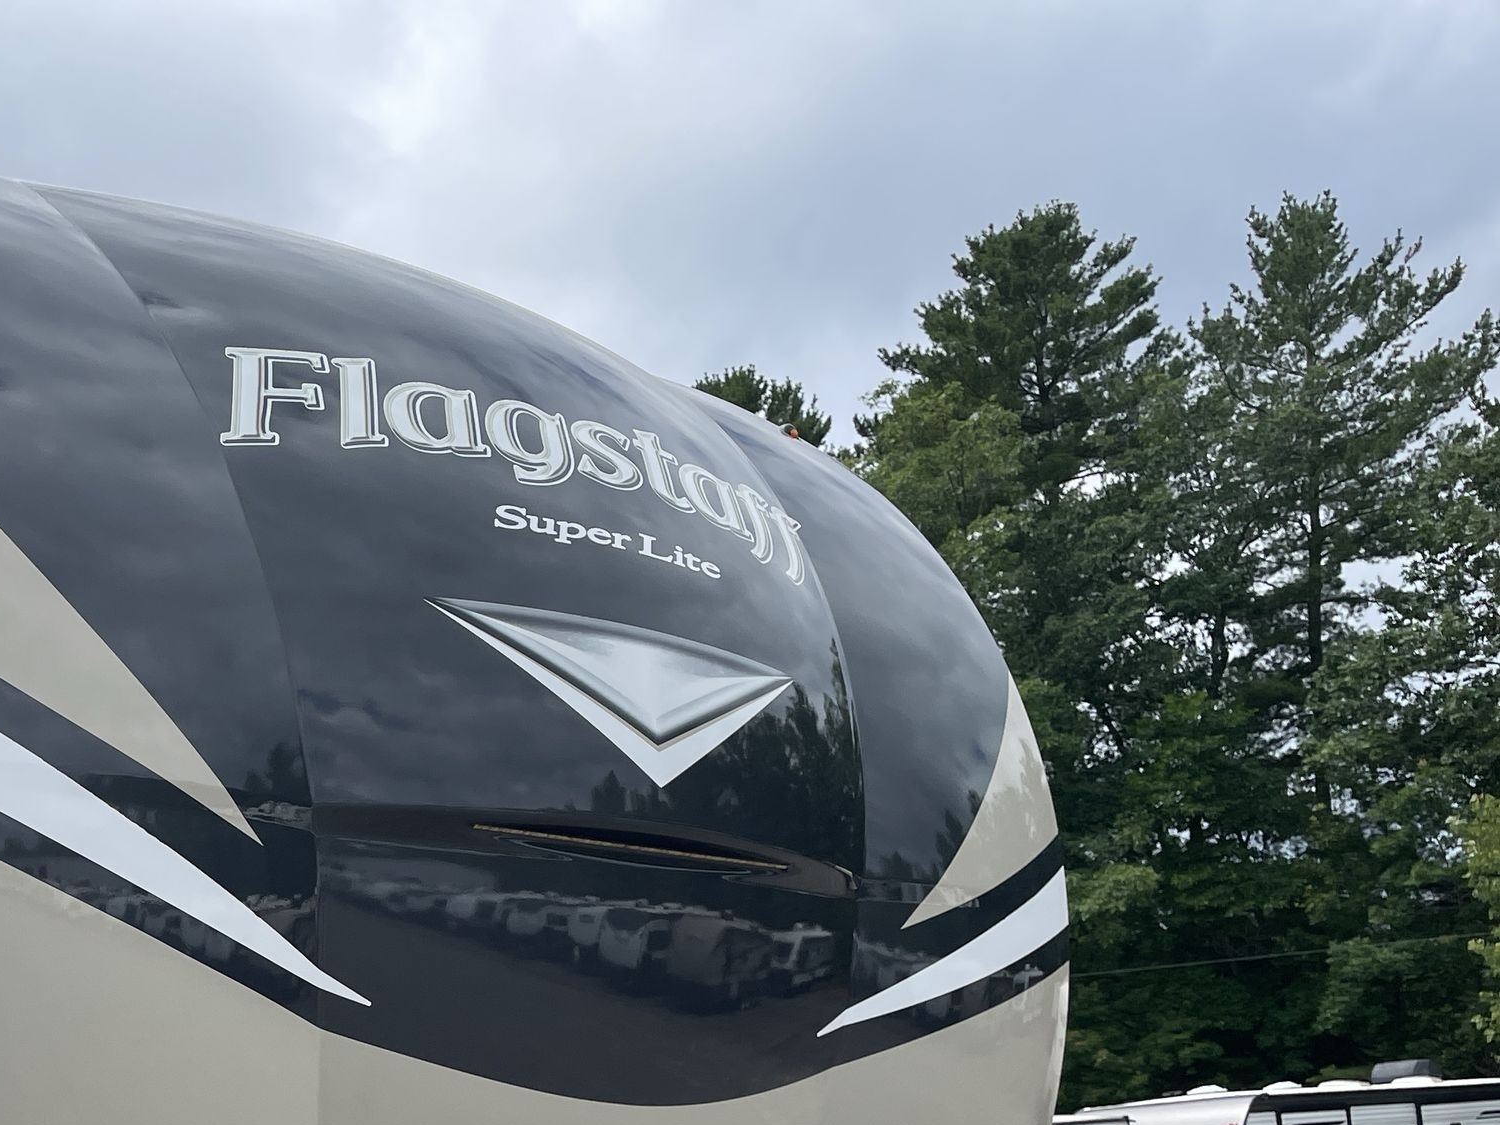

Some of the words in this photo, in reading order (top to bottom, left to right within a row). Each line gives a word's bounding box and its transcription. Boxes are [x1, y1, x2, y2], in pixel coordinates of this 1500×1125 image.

[220, 346, 802, 586] Flagstaff
[494, 504, 631, 549] Super
[636, 533, 722, 580] Lite
